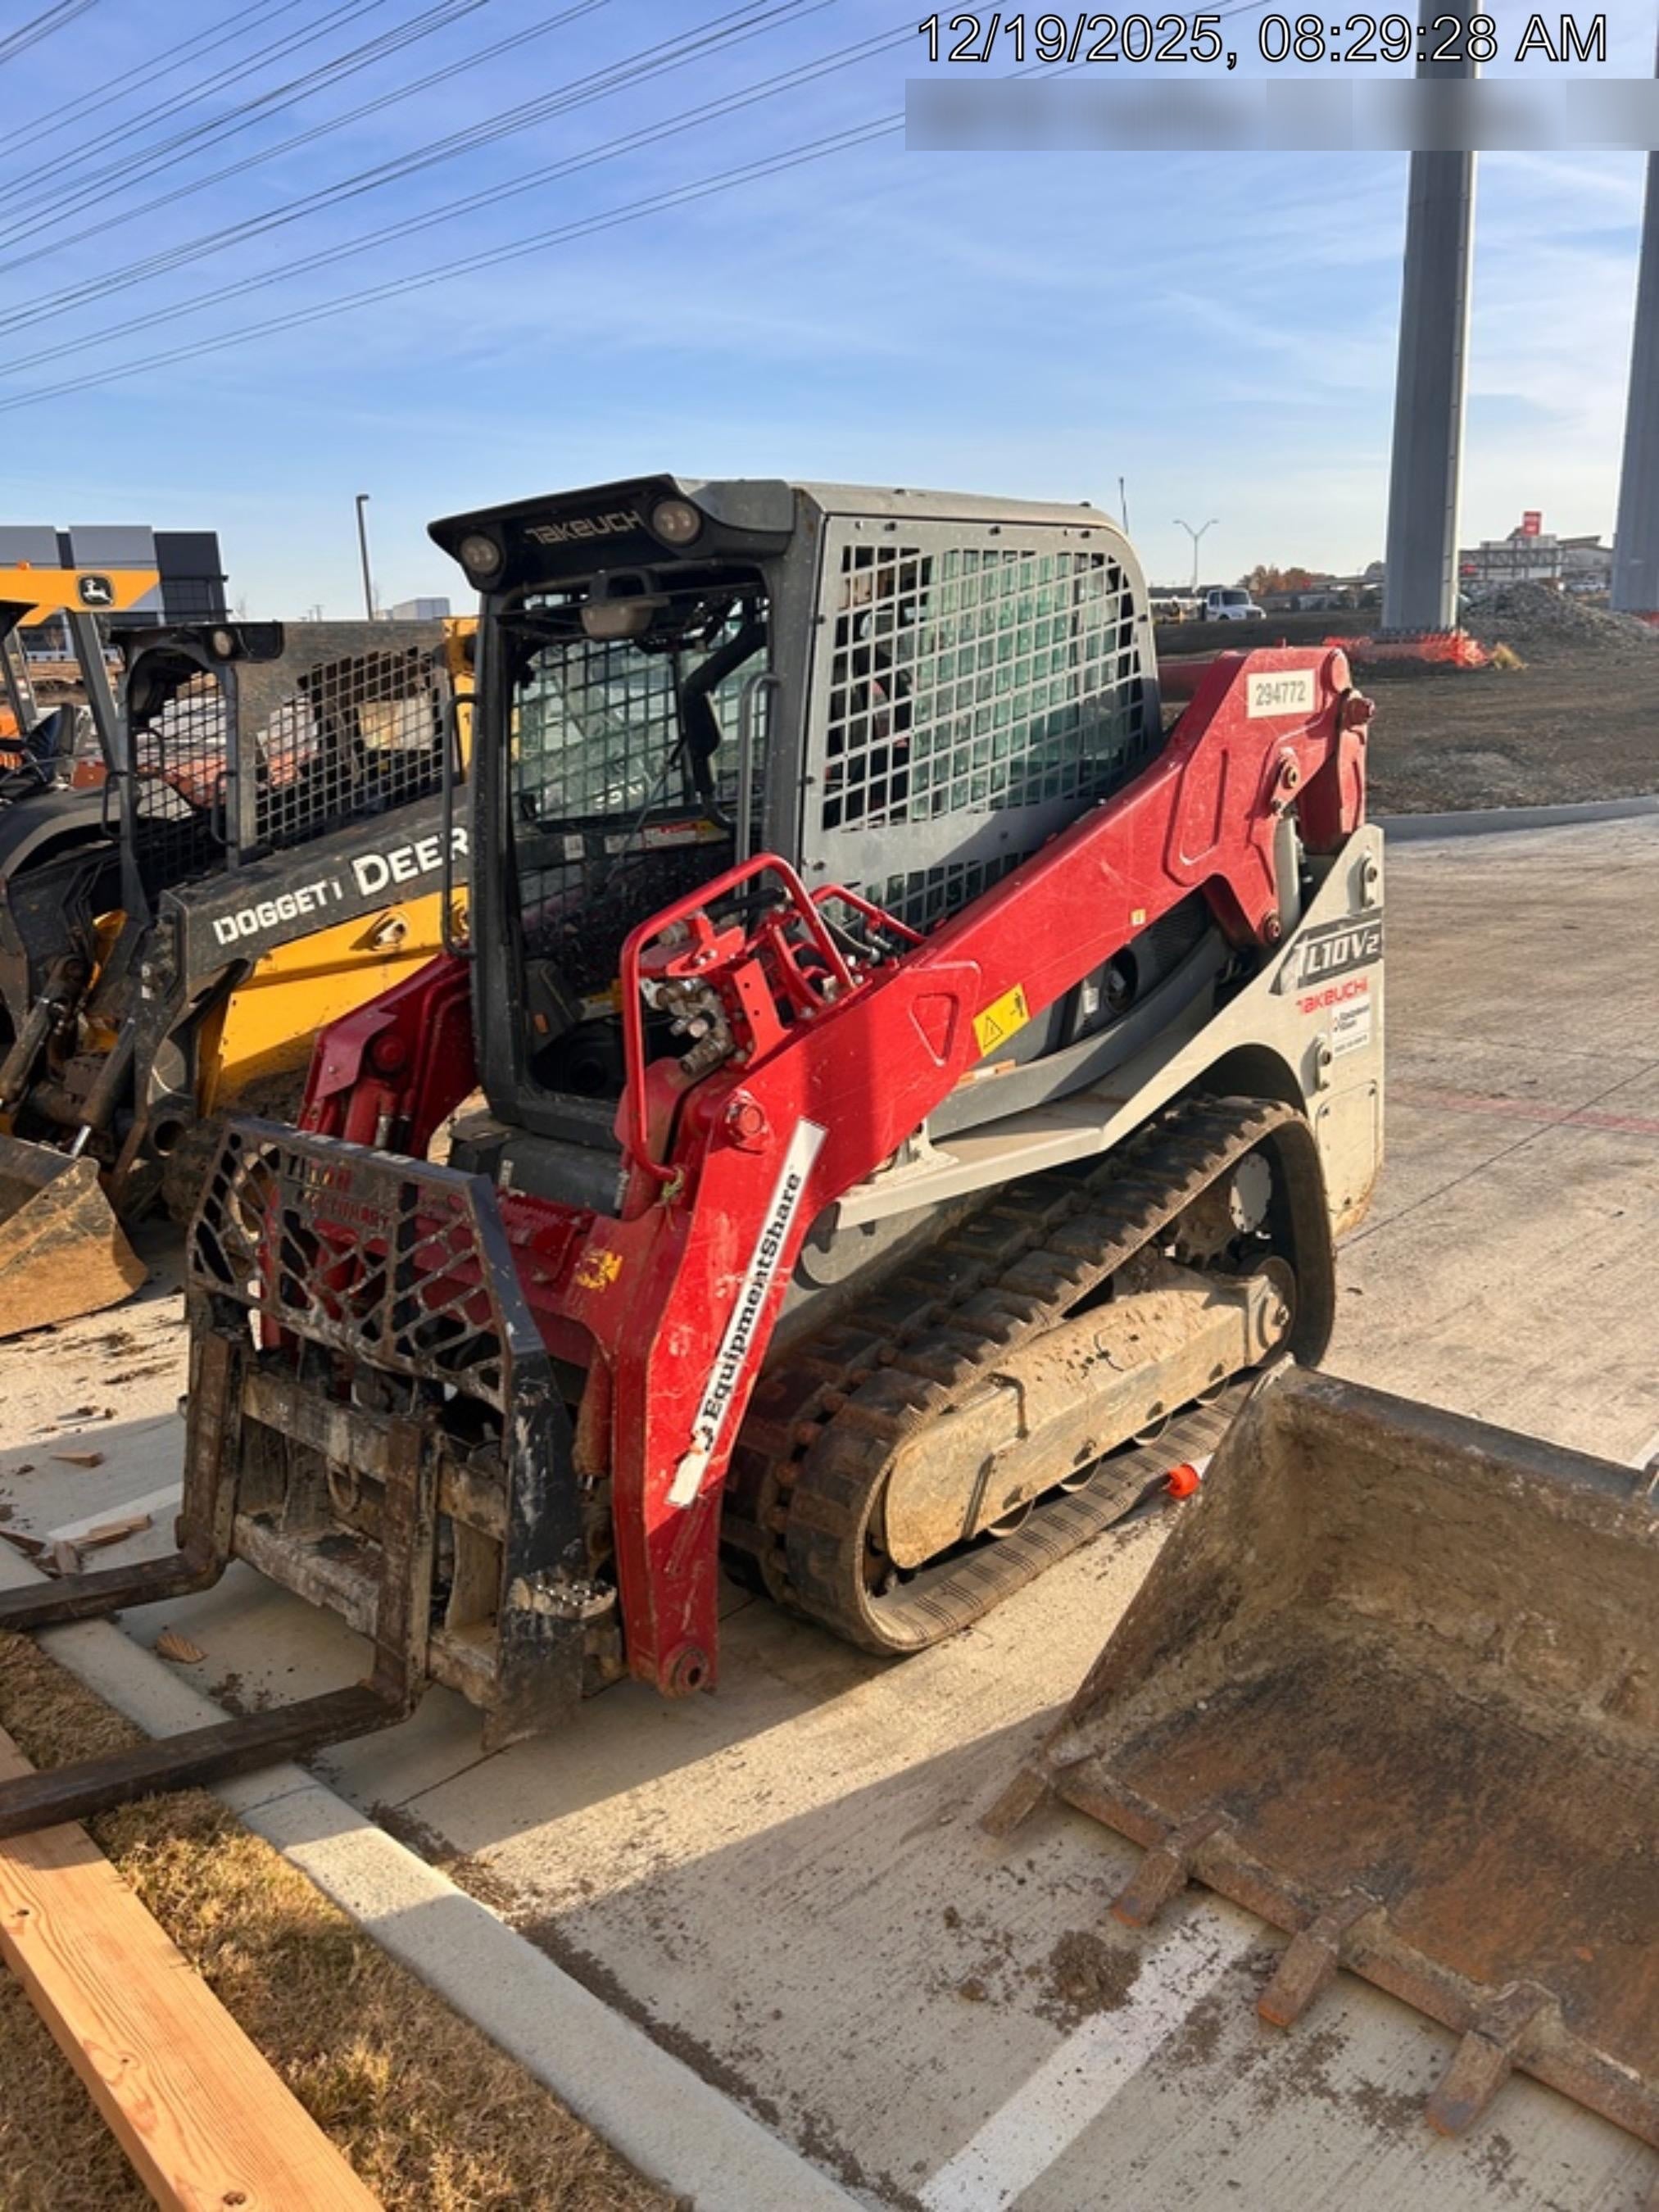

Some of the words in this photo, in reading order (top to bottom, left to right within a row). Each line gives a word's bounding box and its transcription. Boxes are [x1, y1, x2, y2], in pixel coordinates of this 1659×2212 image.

[524, 510, 646, 544] TAKEUCH
[1255, 680, 1307, 706] 294772
[351, 827, 469, 896] DEER
[701, 1172, 801, 1422] EquipmentShare
